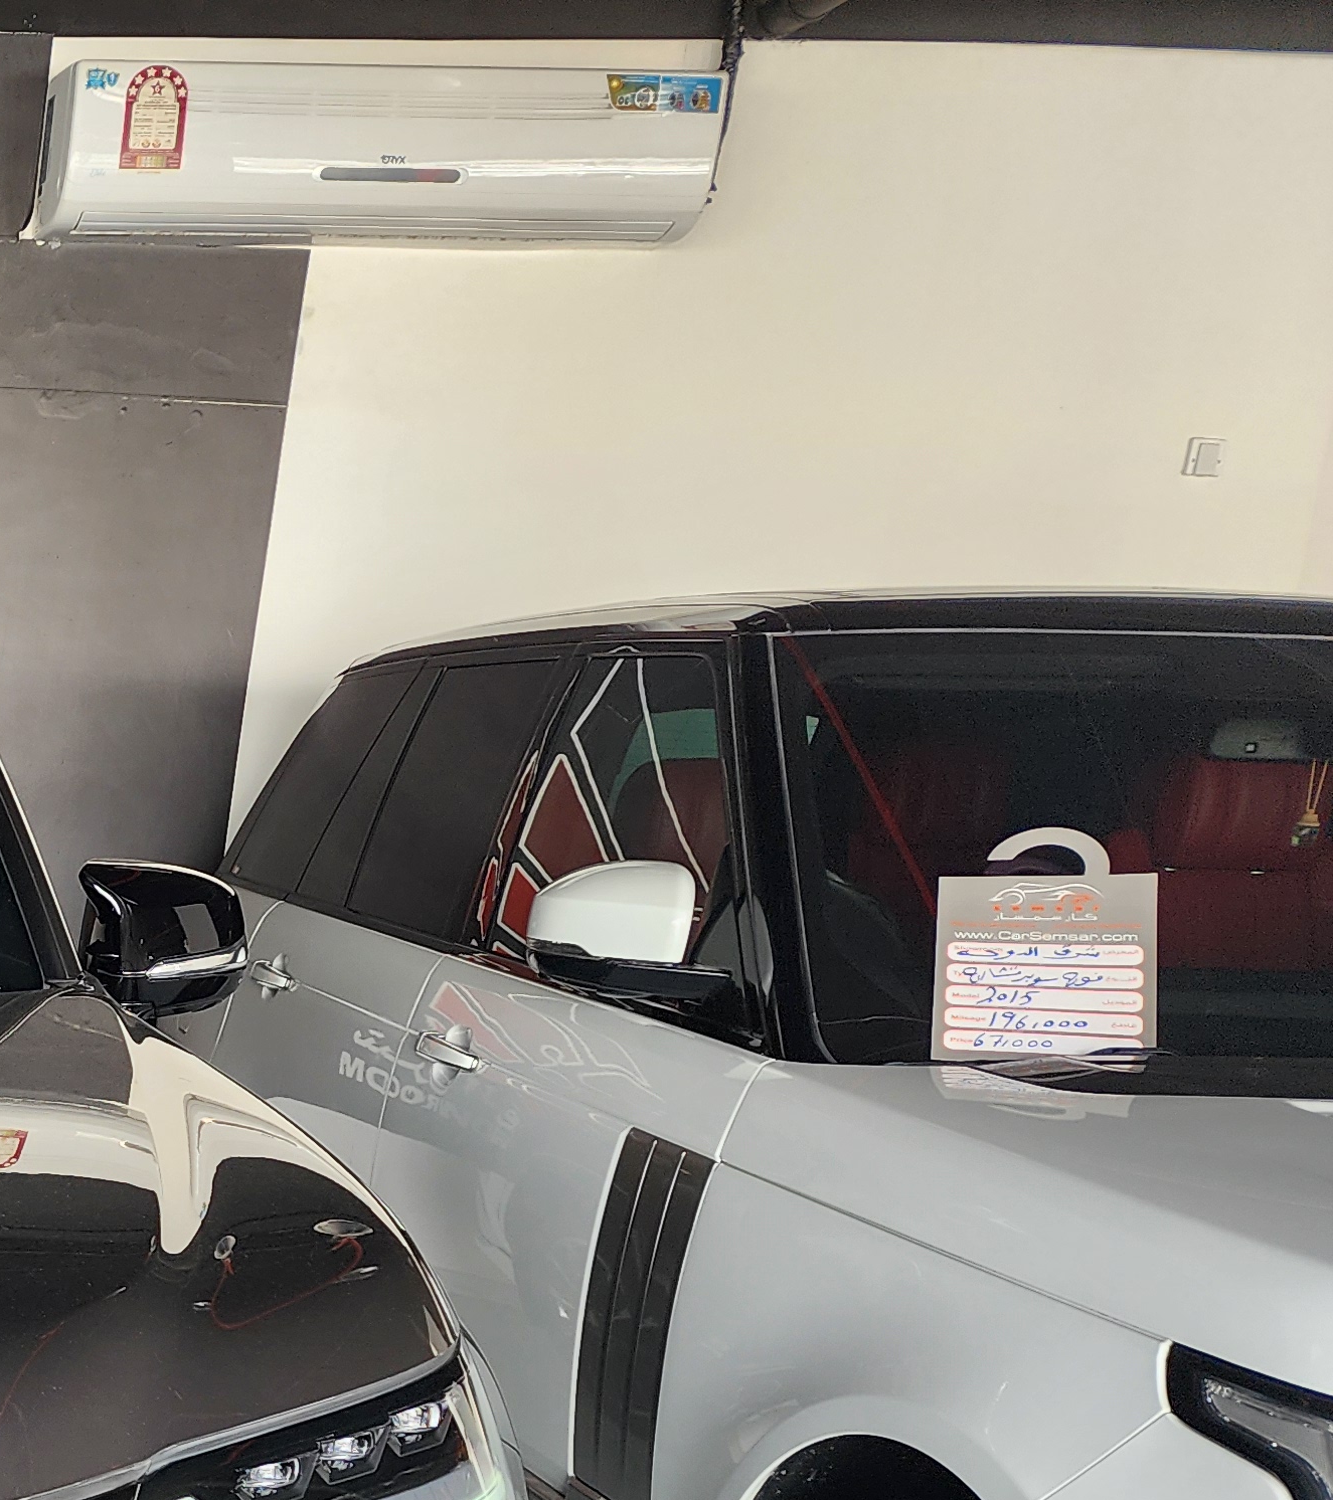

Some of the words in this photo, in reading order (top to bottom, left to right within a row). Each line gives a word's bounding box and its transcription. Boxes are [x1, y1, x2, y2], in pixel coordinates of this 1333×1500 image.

[954, 931, 1139, 942] www.CarSemsar.com
[976, 986, 1041, 1005] 2015
[989, 1011, 1088, 1030] 196,000
